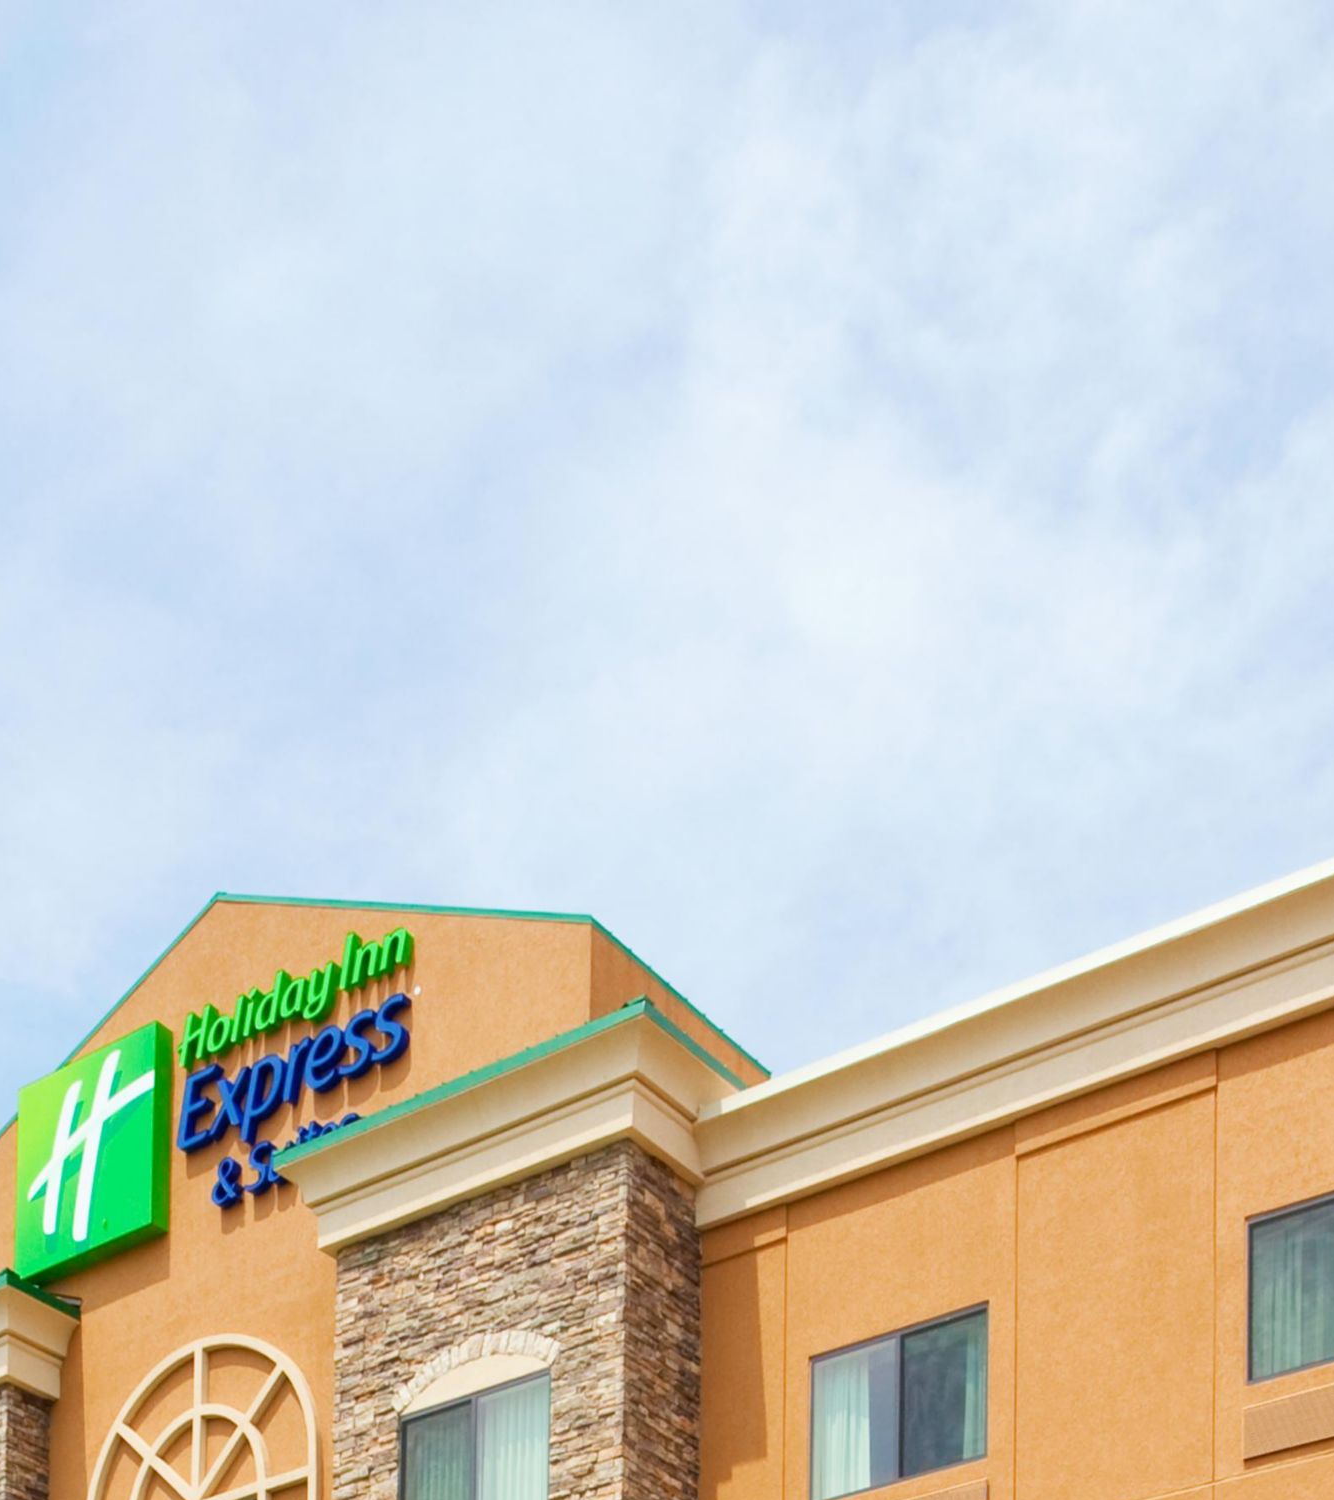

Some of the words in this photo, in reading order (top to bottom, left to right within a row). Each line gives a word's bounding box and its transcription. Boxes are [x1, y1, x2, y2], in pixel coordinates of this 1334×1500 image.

[176, 993, 412, 1153] Express
[178, 960, 342, 1074] Holiday
[339, 927, 414, 993] Inn
[211, 1157, 244, 1209] &
